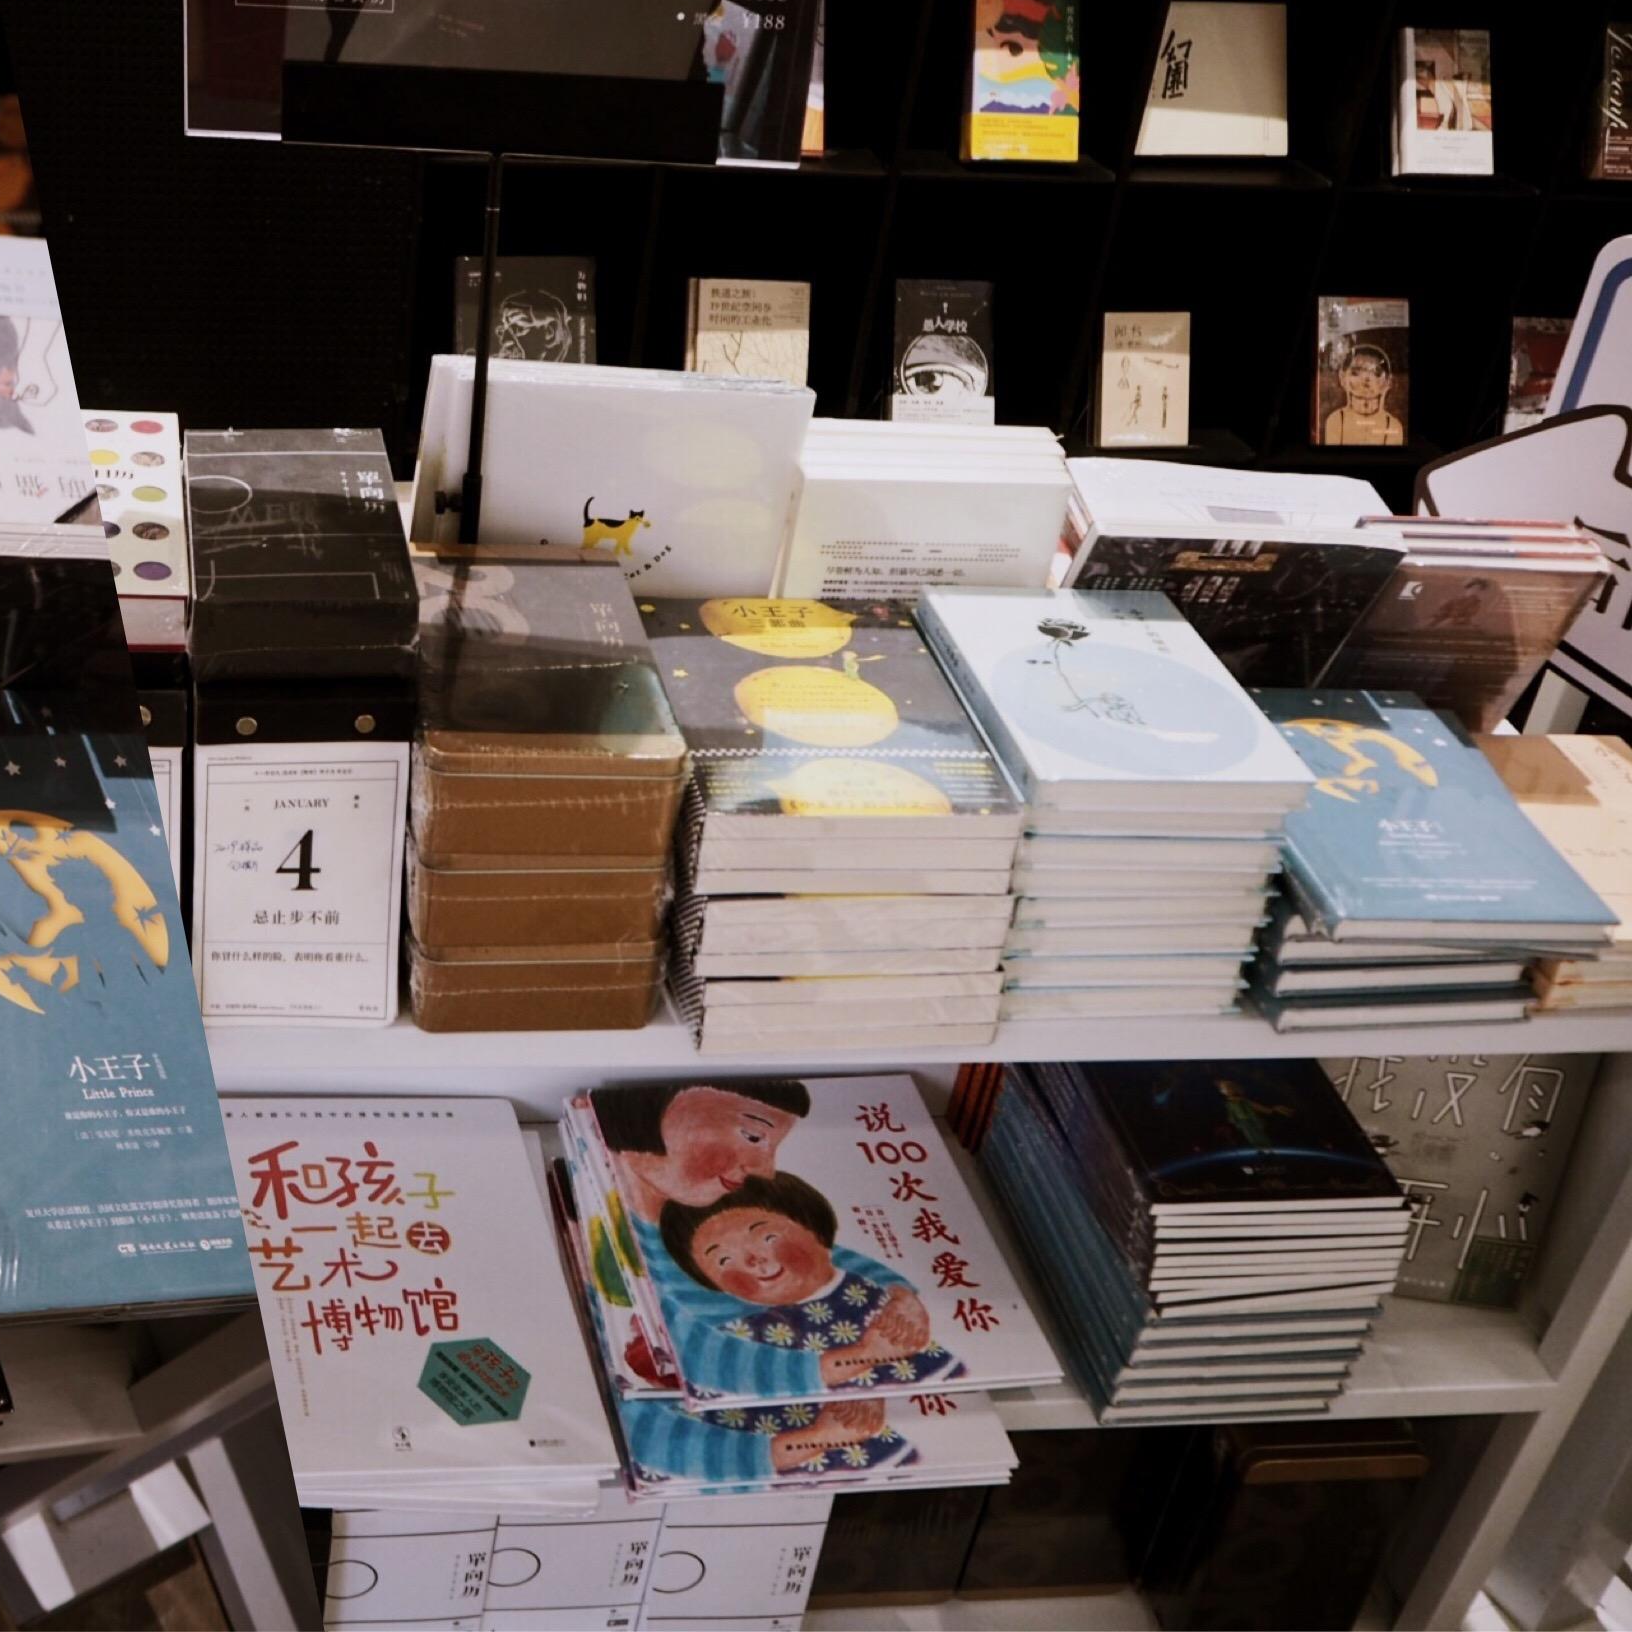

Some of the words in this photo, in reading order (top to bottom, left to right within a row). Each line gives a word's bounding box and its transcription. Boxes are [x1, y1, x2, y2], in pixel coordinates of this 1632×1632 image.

[730, 603, 815, 622] 小王子
[273, 796, 331, 812] JANUARY
[274, 827, 322, 893] 4
[251, 906, 342, 927] 忌止步不前
[67, 1053, 151, 1085] 小王子
[81, 1087, 117, 1101] Little
[118, 1086, 155, 1099] Prince
[249, 1139, 457, 1221] 和孩子
[291, 1212, 451, 1257] 一起去
[249, 1236, 401, 1293] 艺术
[301, 1276, 462, 1356] 博物馆
